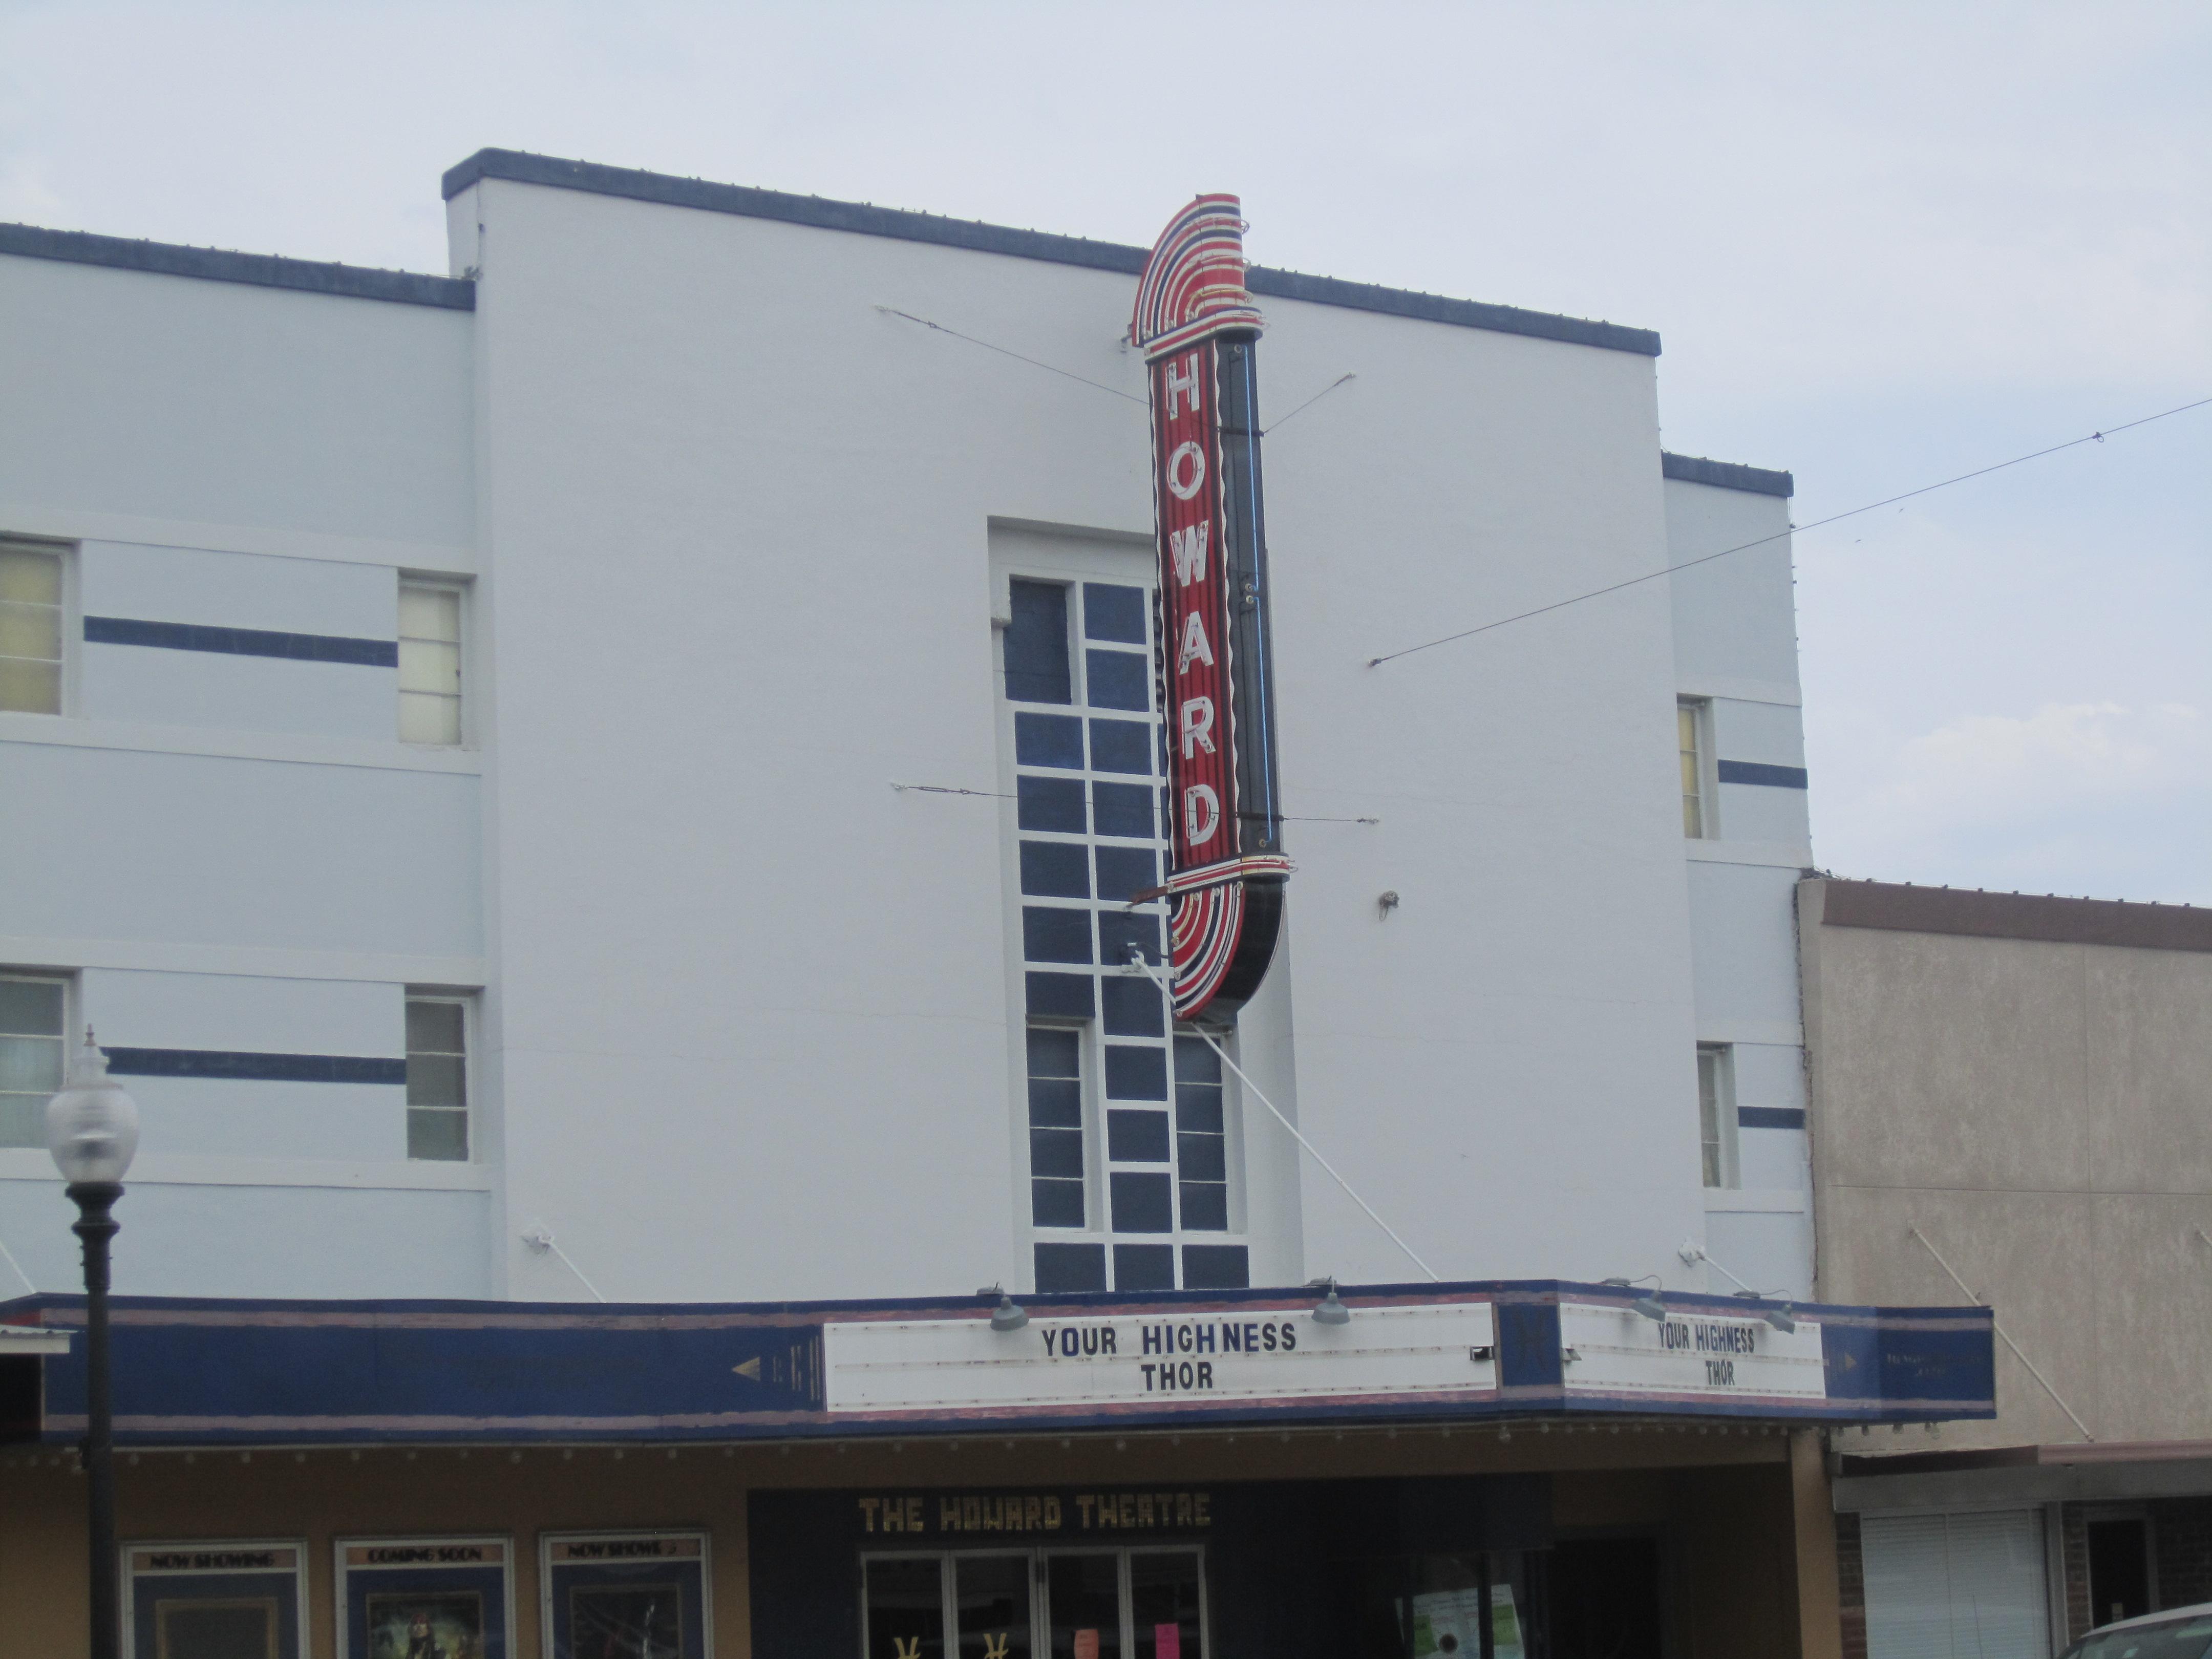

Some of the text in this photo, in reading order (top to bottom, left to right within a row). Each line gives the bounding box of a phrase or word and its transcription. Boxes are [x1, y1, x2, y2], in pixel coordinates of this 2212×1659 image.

[1165, 353, 1220, 846] HOWARD
[1041, 1322, 1297, 1357] YOUR HIGHNESS
[1658, 1322, 1755, 1354] YOUR HIGHNESS
[1140, 1361, 1214, 1391] THOR
[1706, 1359, 1735, 1386] THOR
[859, 1493, 1211, 1533] THE HOWARD THEATRE
[151, 1552, 274, 1568] NOW SHOWING
[368, 1547, 482, 1564] COMING SOON
[568, 1542, 605, 1558] NOW
